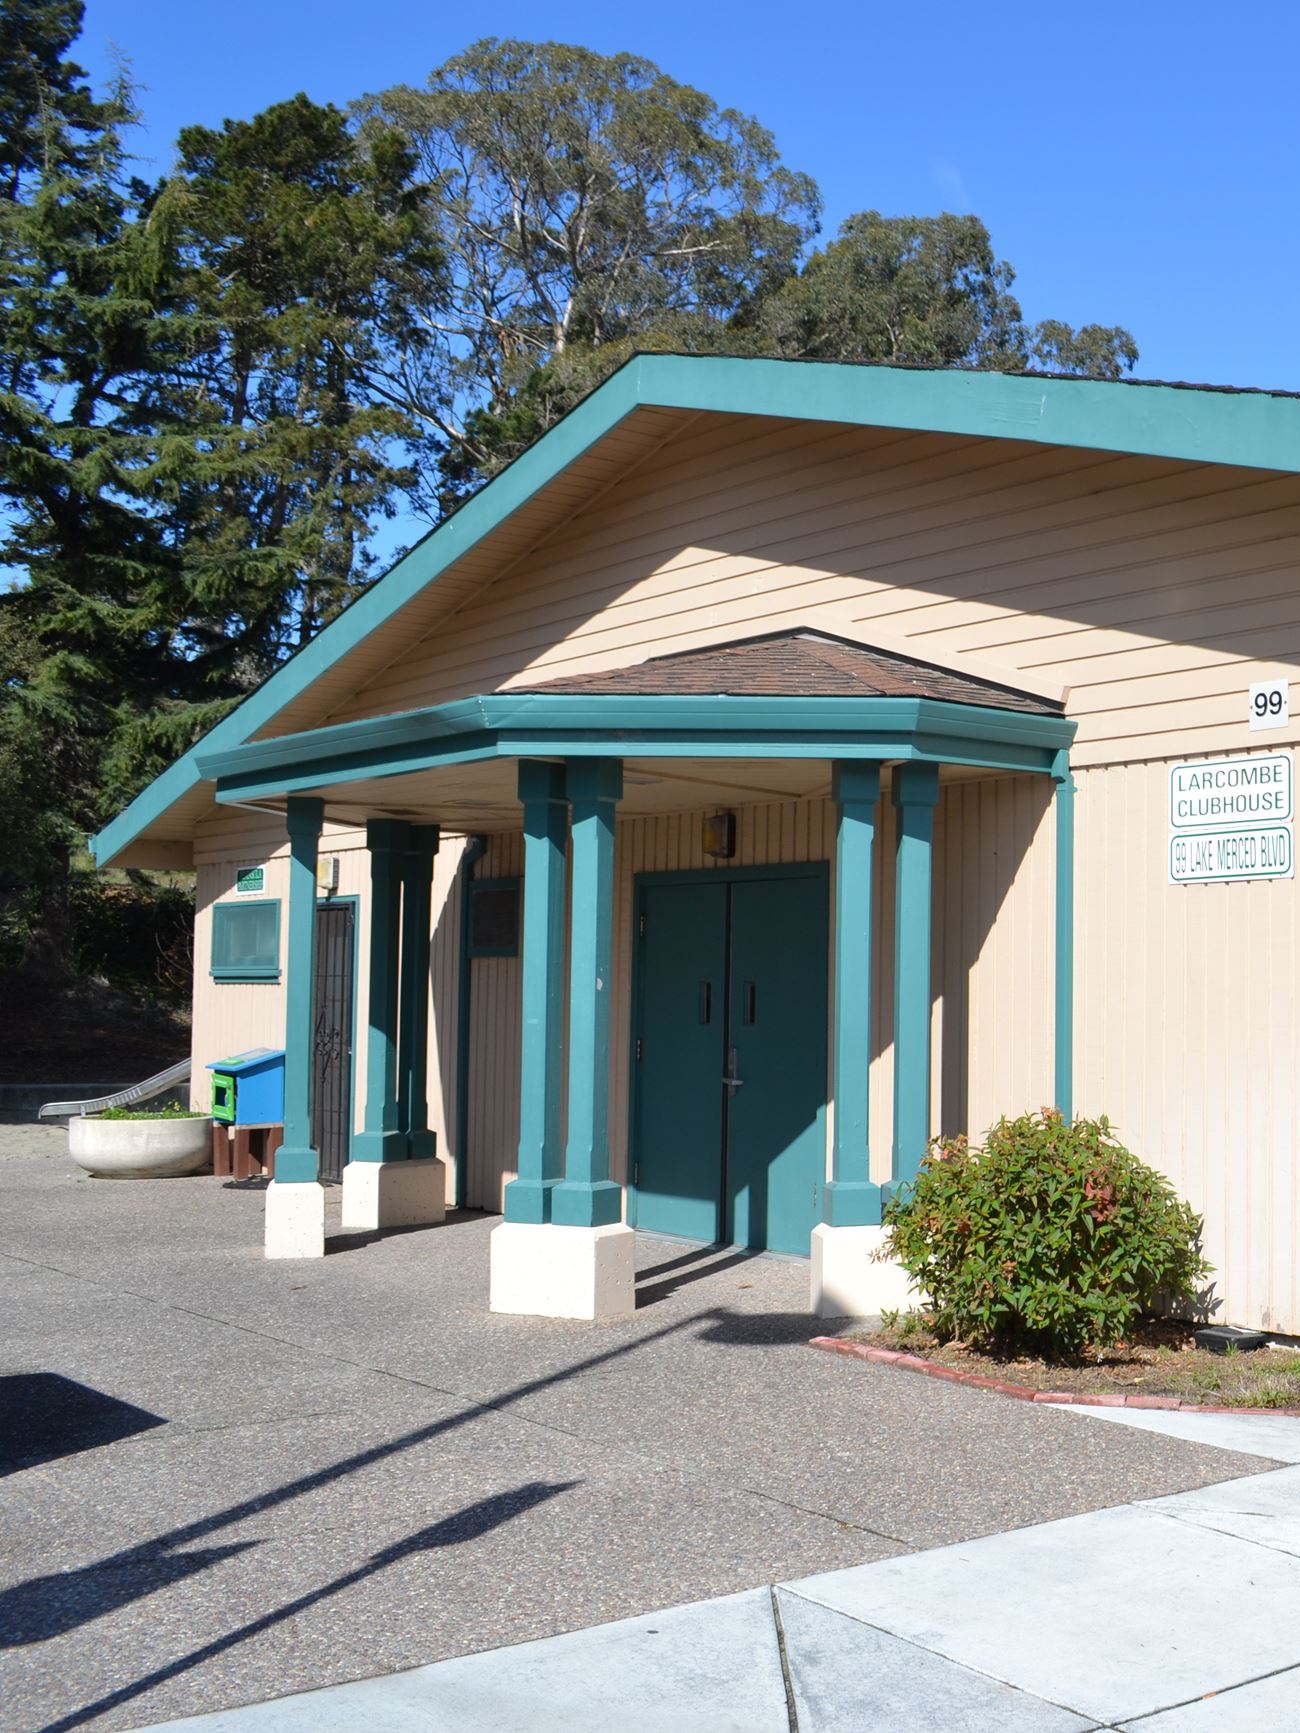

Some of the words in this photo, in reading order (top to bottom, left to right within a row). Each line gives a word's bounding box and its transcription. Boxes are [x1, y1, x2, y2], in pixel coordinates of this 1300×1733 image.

[1254, 690, 1282, 717] 99
[1178, 764, 1284, 792] LARCOMBE
[1178, 791, 1285, 818] CLUBHOUSE
[1175, 842, 1187, 874] 99
[1190, 840, 1213, 872] LAKE
[1217, 836, 1257, 870] MERCED
[1260, 834, 1286, 868] BLVD
